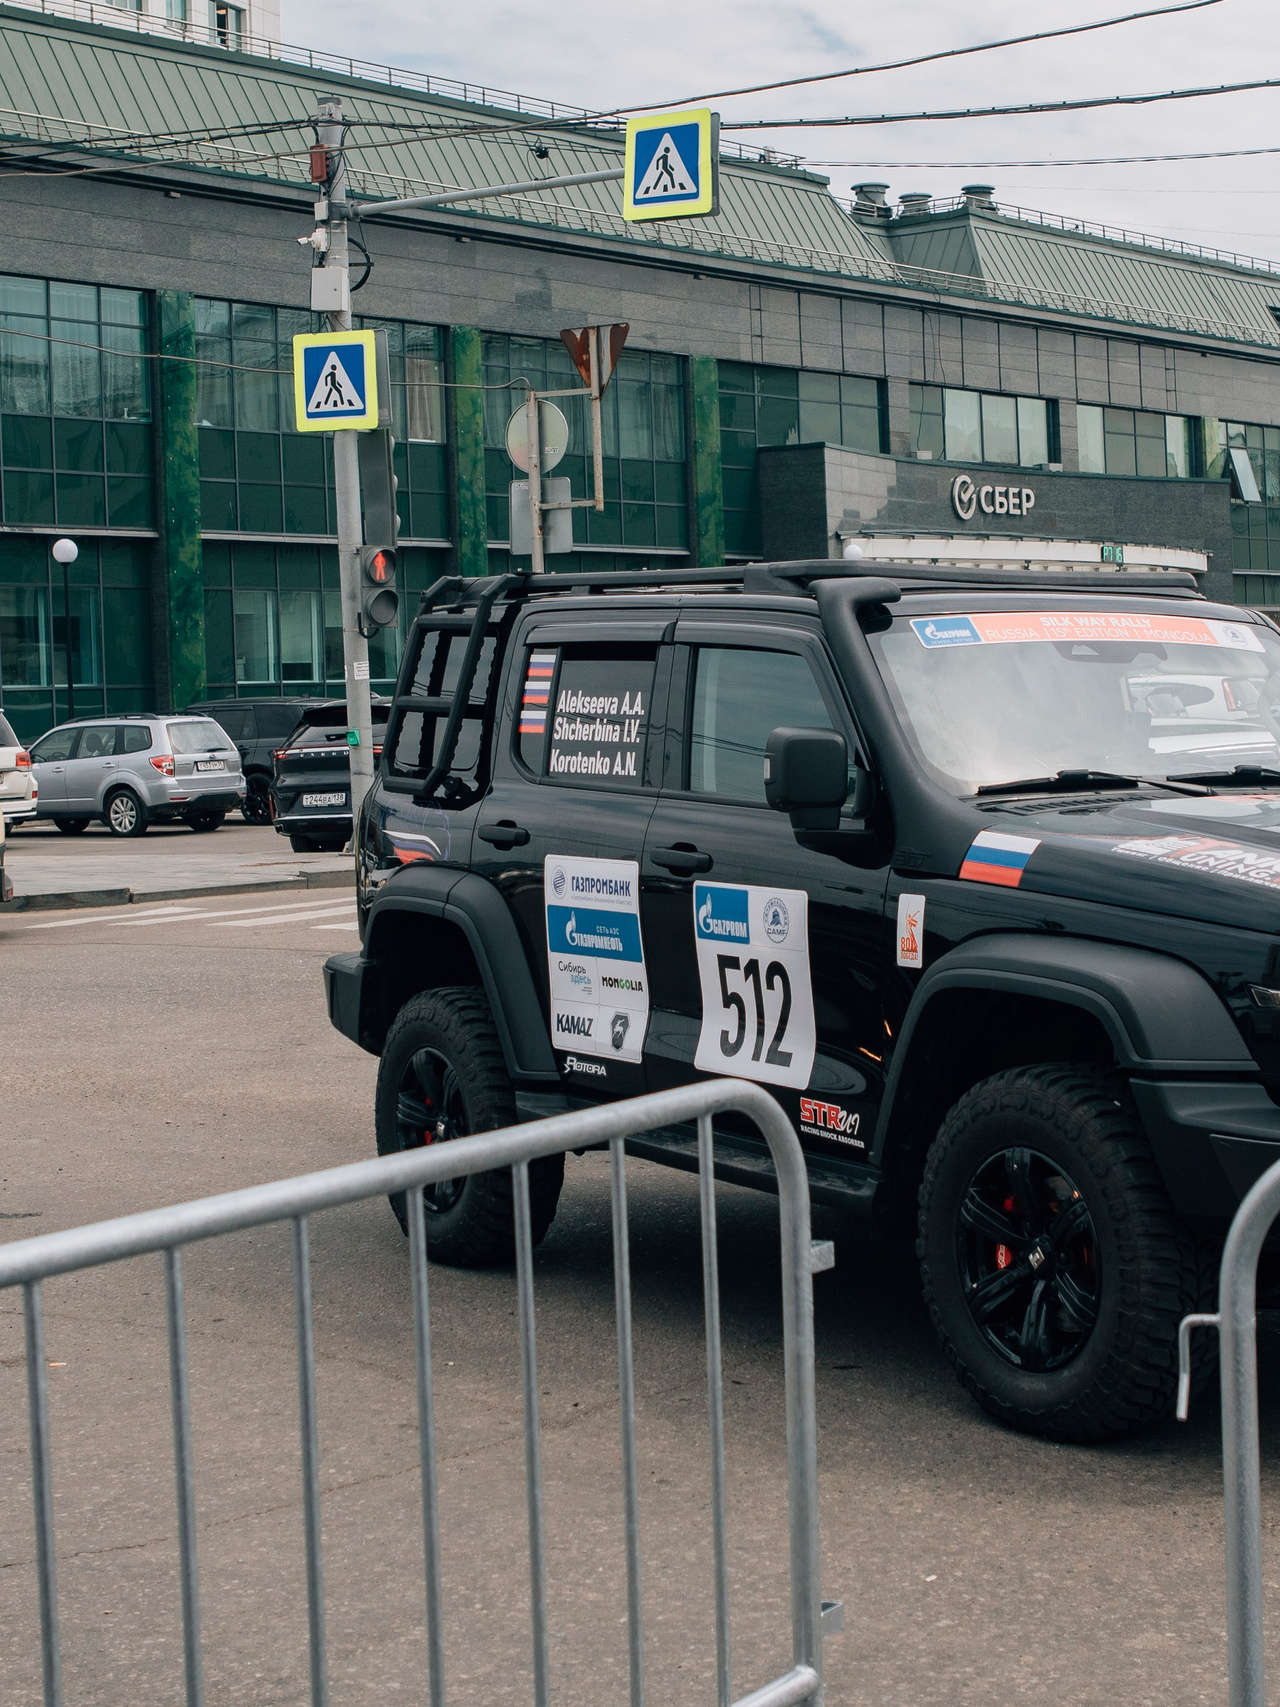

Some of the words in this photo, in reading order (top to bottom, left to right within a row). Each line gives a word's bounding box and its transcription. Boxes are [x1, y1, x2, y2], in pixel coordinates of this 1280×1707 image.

[980, 485, 1035, 516] СБЕР
[1040, 616, 1074, 627] SILK
[1074, 616, 1106, 627] WAY
[1108, 617, 1152, 628] RALLY
[985, 628, 1041, 640] RUSSIA
[1073, 627, 1130, 638] EDITION
[1143, 628, 1214, 643] MONGOLIA
[557, 690, 619, 715] Alekseeva
[620, 691, 645, 715] A.A.
[554, 717, 620, 742] Shcherbina
[623, 719, 640, 743] I.V.
[550, 749, 611, 775] Korotenko
[613, 751, 637, 776] A.N.
[571, 876, 631, 897] ГАЗПРОМБАНК
[713, 919, 748, 938] GAZPROM
[577, 932, 623, 952] ГАЗПРОМНЕФТЬ
[900, 937, 911, 950] 80
[558, 961, 587, 975] Сибирь
[570, 975, 592, 985] здесь
[601, 976, 644, 992] MONGOLIA
[716, 953, 793, 1068] 512
[556, 1013, 594, 1037] KAMAZ
